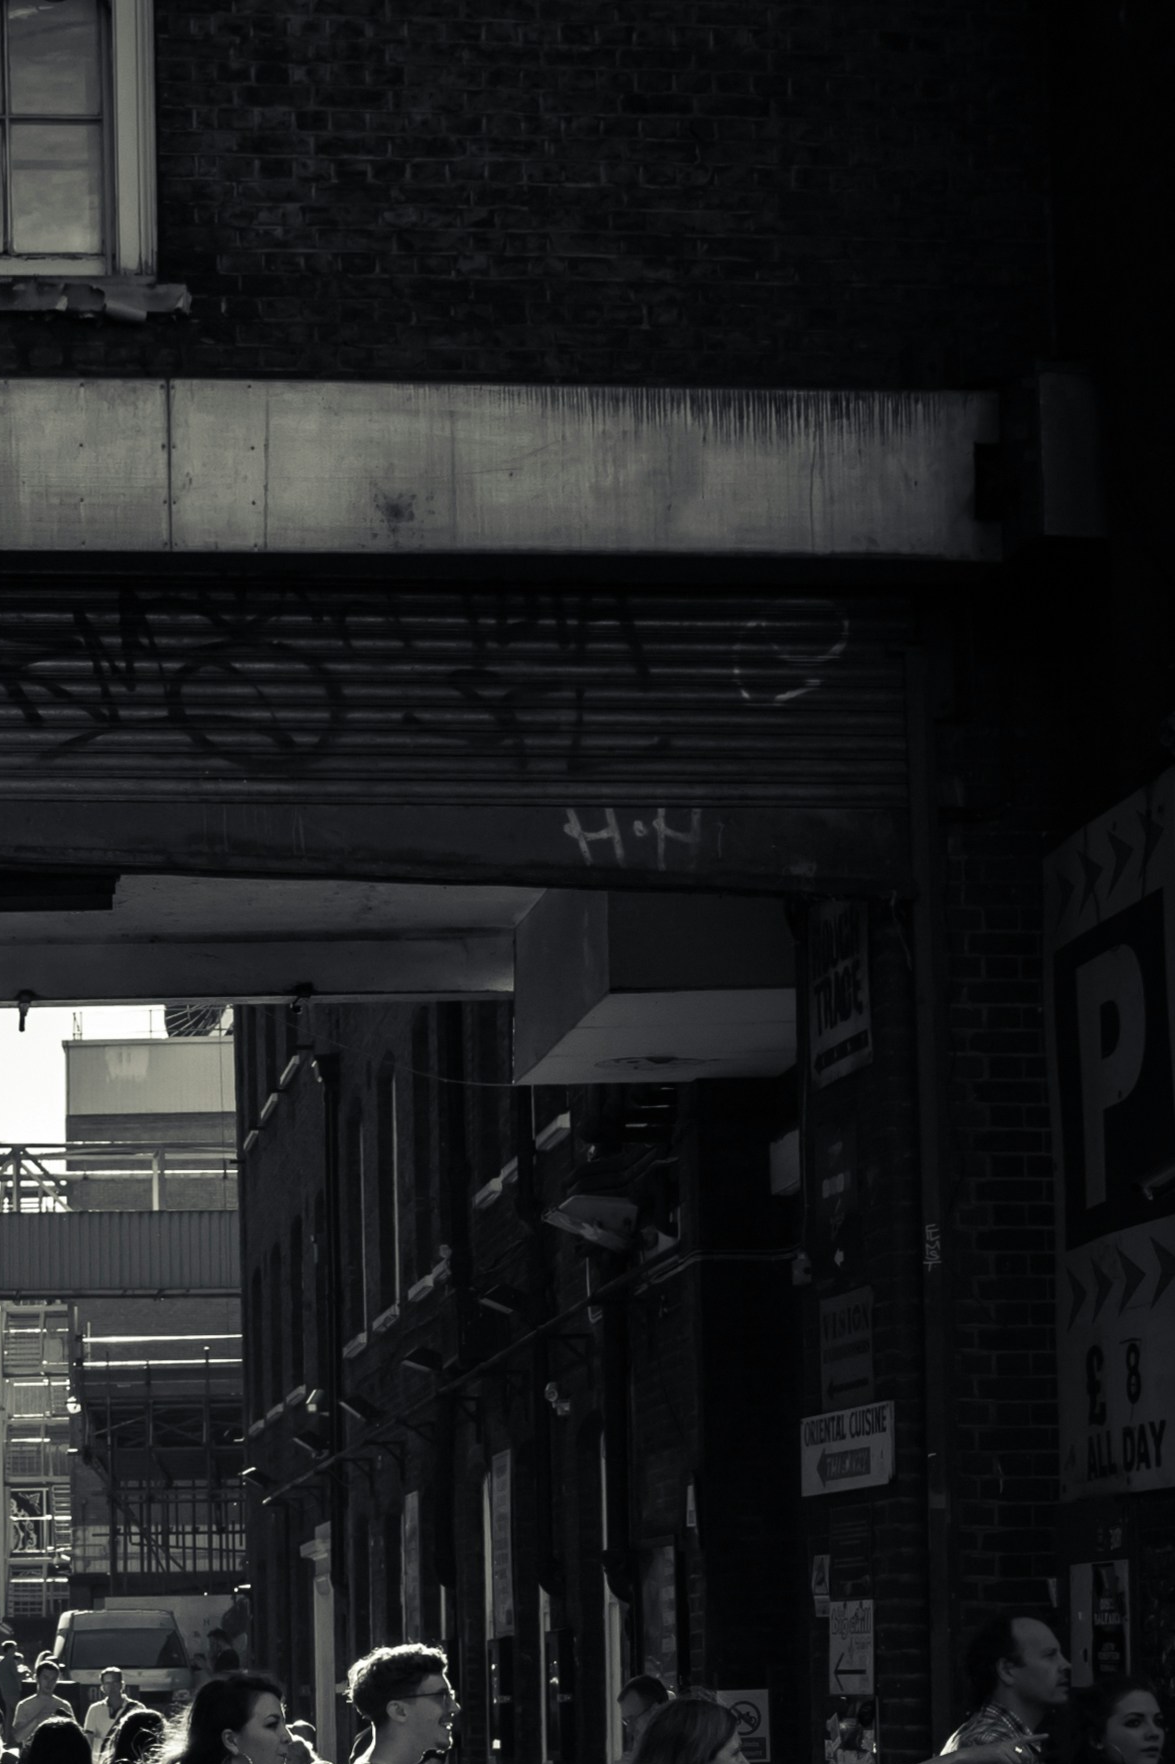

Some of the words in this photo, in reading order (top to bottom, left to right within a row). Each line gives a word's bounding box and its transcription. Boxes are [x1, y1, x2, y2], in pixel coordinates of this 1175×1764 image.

[814, 960, 864, 1036] TRADE
[1075, 943, 1147, 1210] P
[803, 1413, 847, 1447] ORIENTAL
[849, 1404, 887, 1439] CUISINE
[1087, 1430, 1117, 1481] ALL
[1122, 1419, 1166, 1472] DAY
